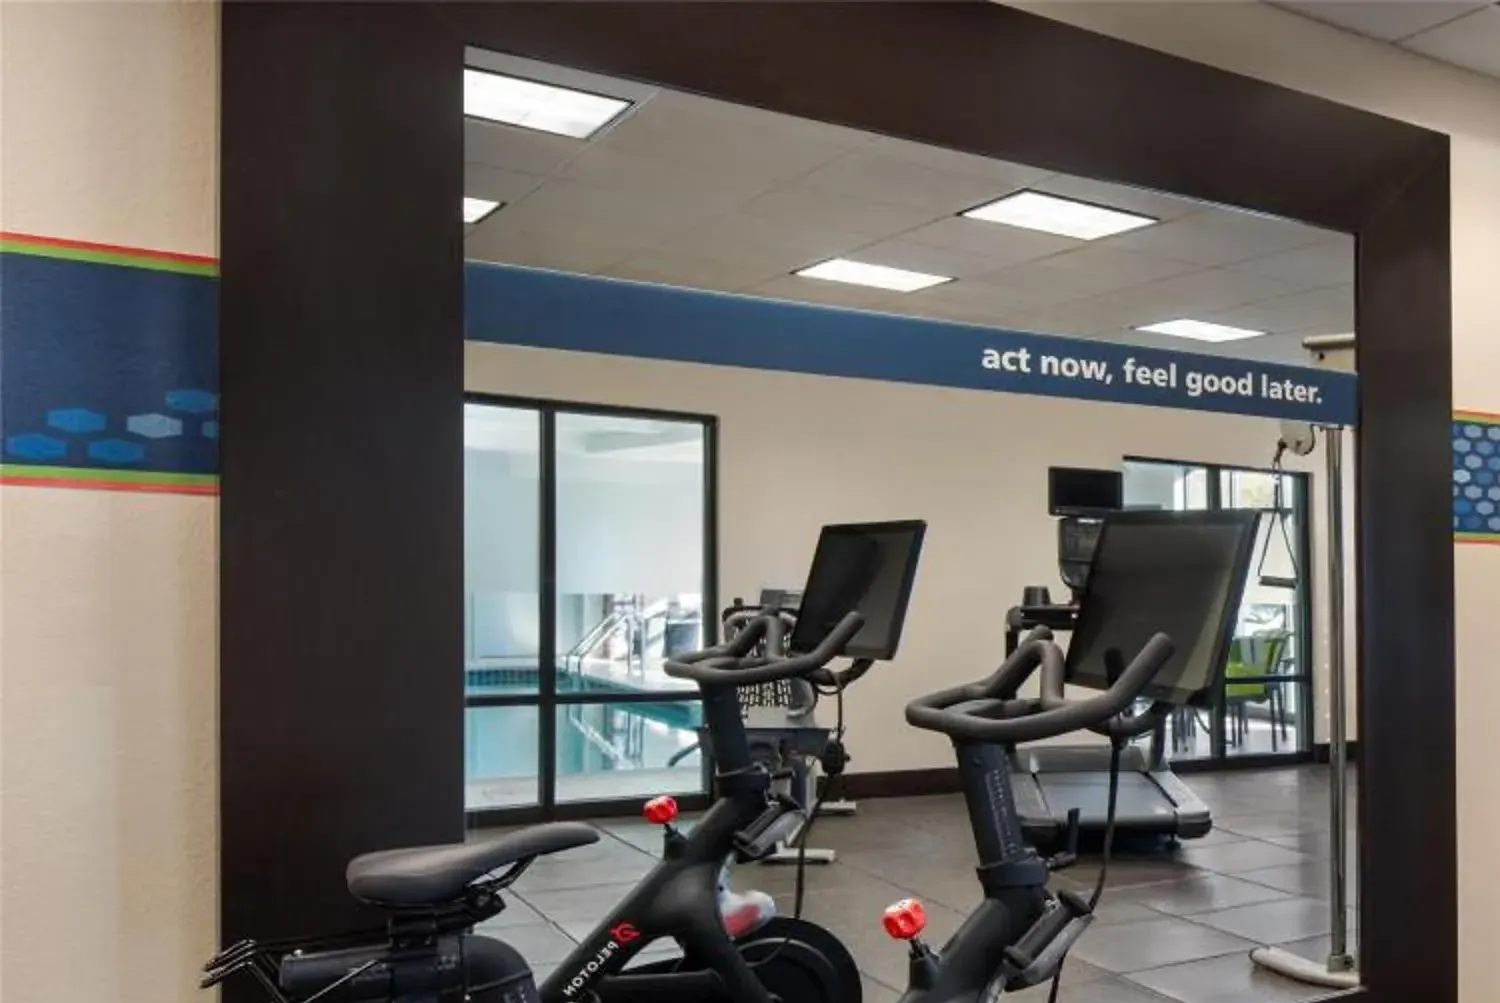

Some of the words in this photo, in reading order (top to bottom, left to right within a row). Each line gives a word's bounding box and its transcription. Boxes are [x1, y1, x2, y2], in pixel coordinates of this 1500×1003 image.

[980, 346, 1031, 374] act
[1040, 354, 1113, 385] now,
[1122, 357, 1177, 388] feel
[1185, 371, 1253, 397] good
[1261, 373, 1324, 404] later.
